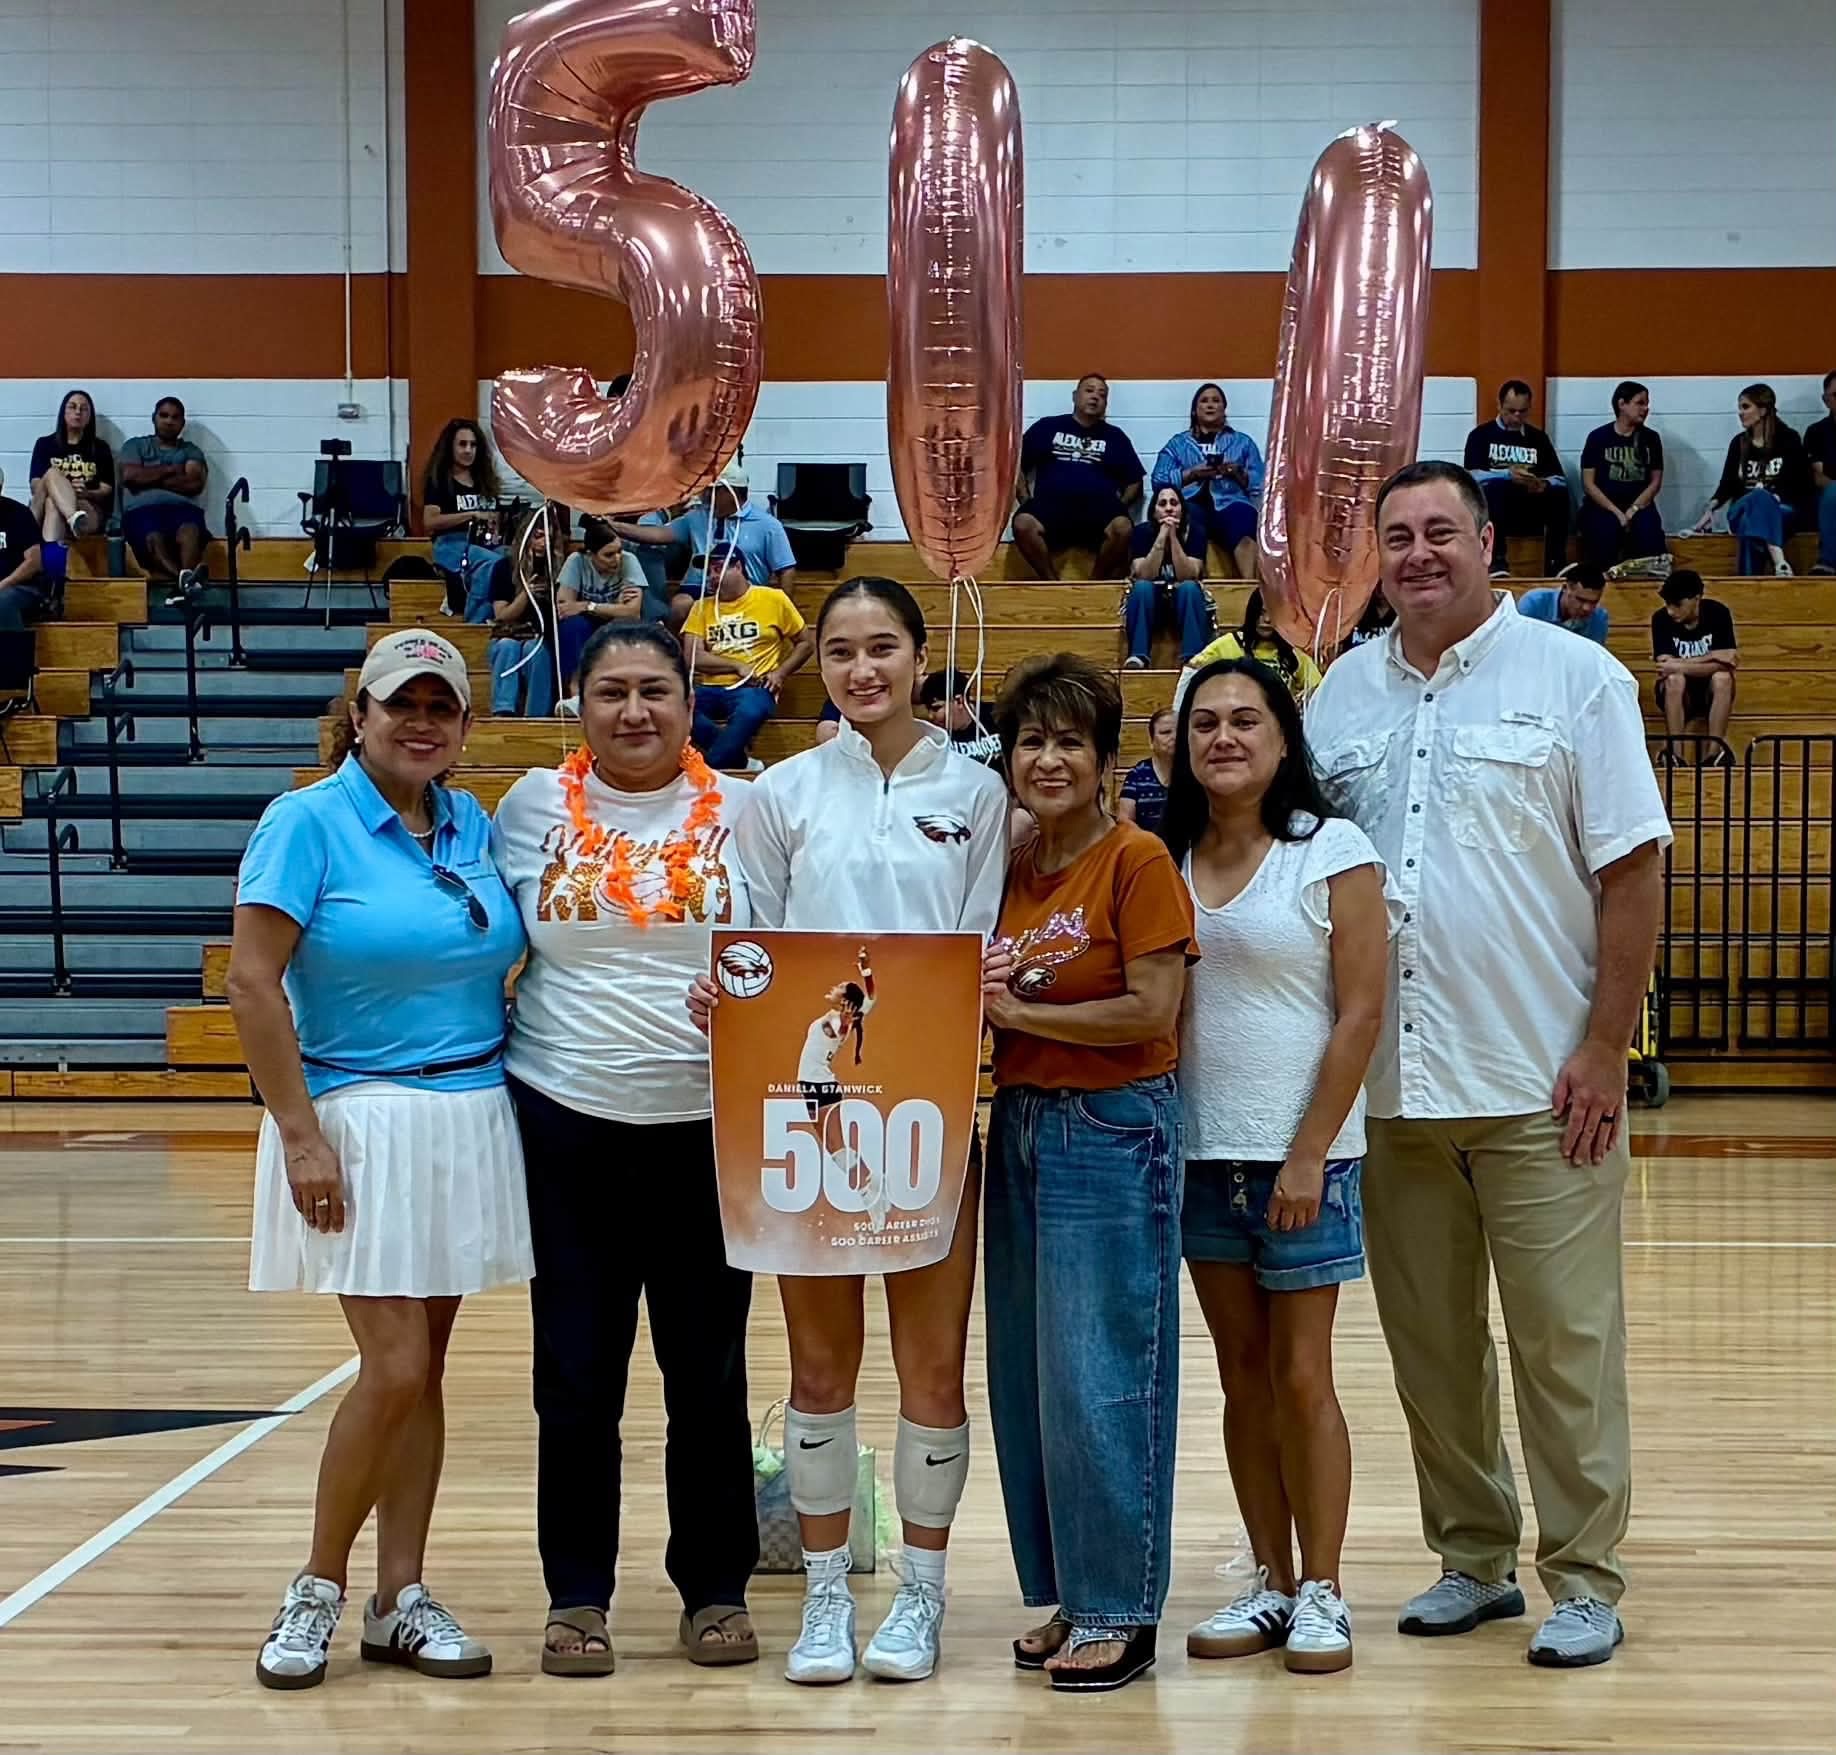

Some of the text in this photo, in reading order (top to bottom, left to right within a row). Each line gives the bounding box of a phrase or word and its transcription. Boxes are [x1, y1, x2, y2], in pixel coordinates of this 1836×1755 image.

[1488, 443, 1538, 464] ALEXANDER
[761, 1099, 944, 1213] 500
[831, 1236, 856, 1246] 500
